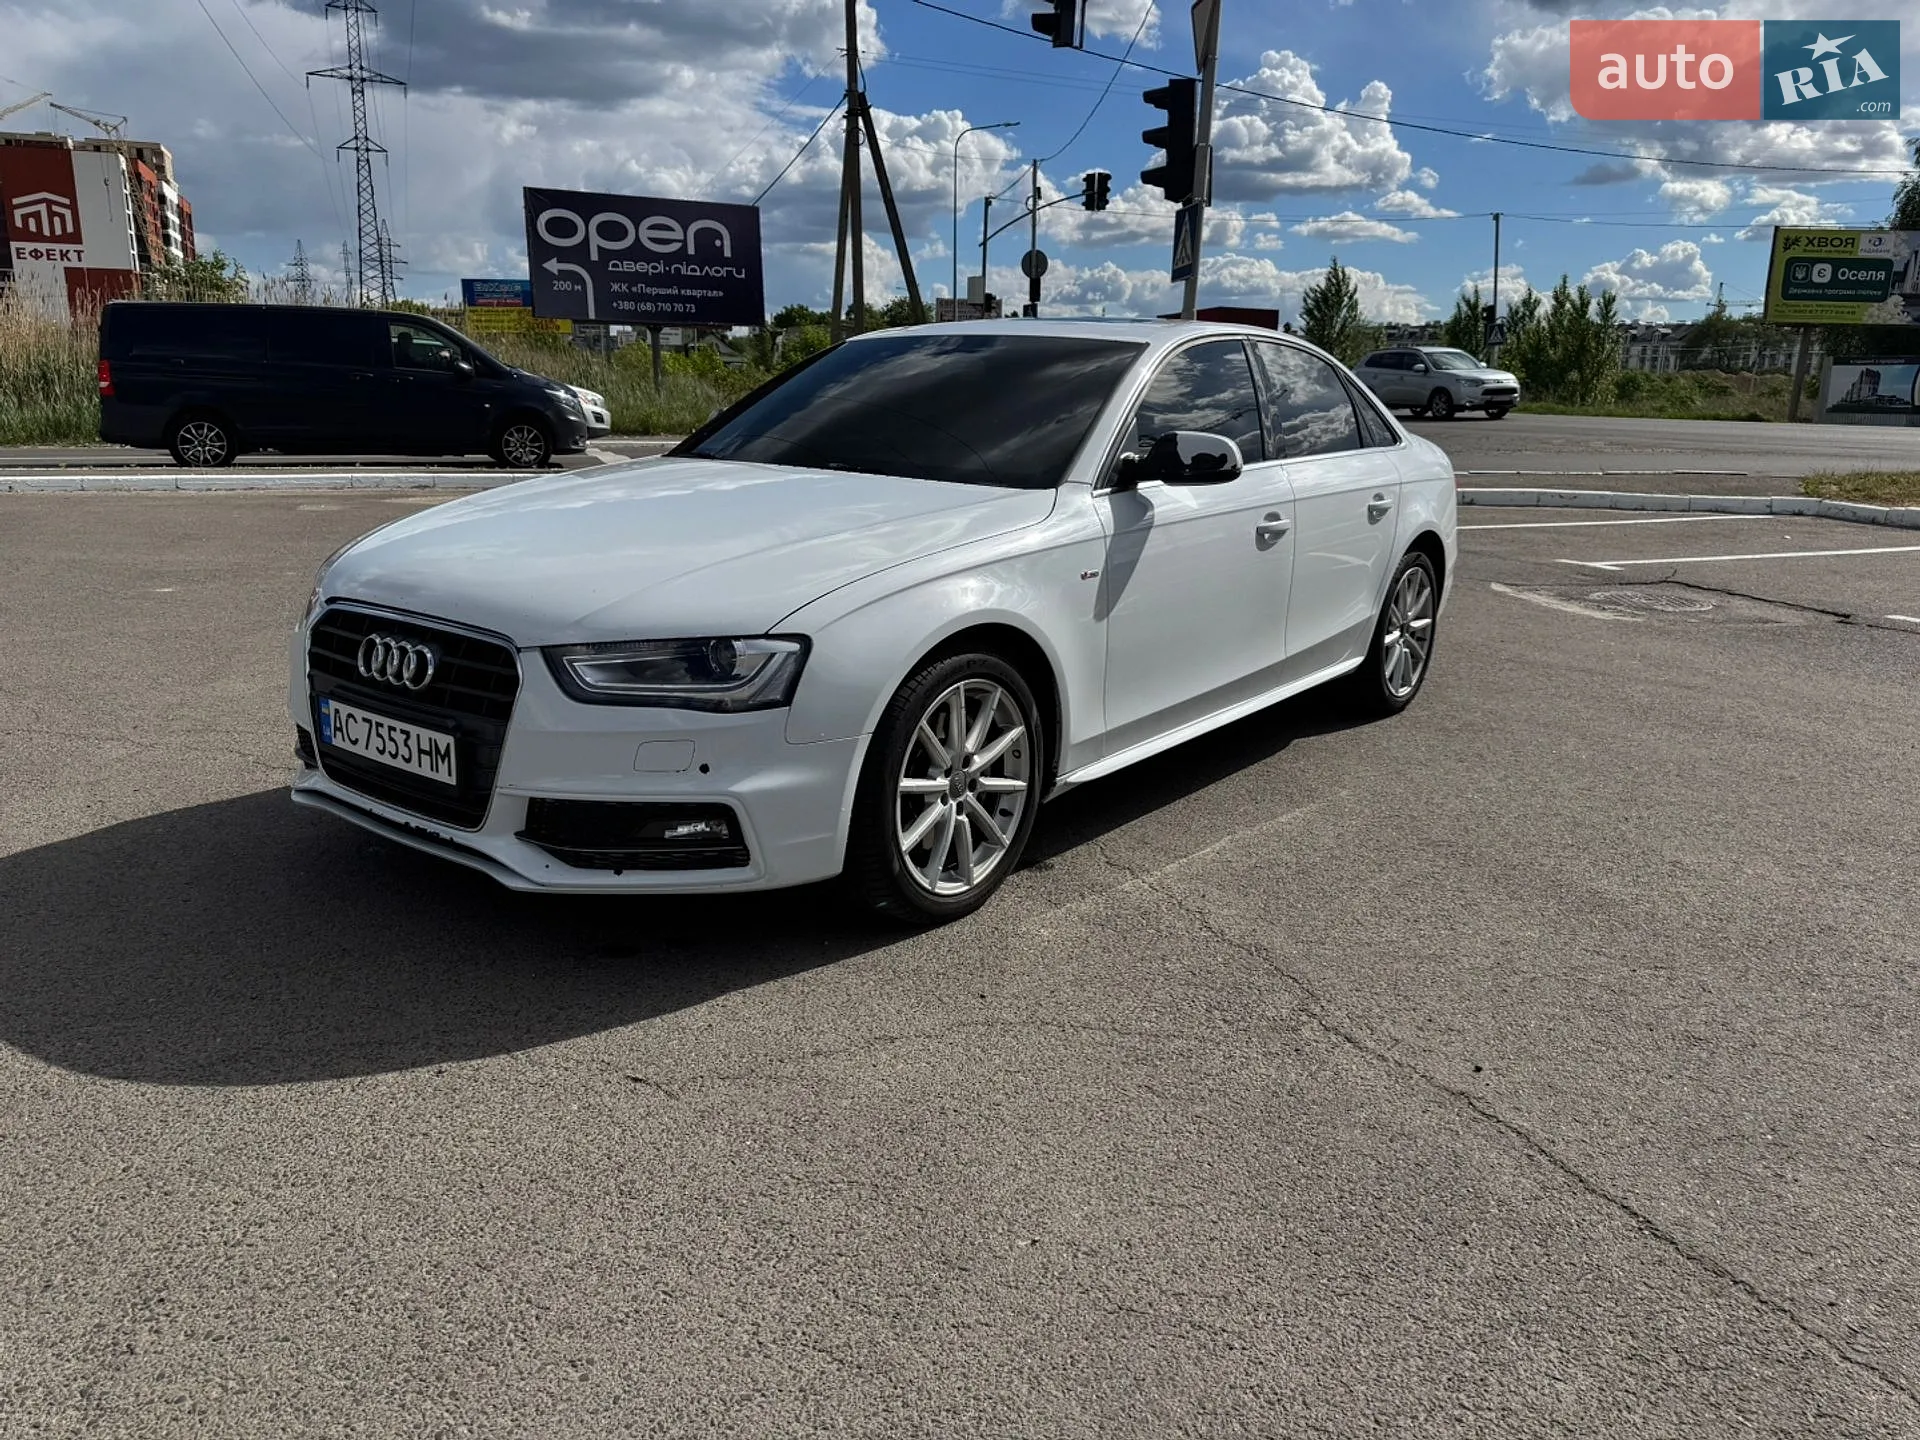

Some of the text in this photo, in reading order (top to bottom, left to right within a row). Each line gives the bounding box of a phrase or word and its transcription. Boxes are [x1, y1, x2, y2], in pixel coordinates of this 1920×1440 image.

[536, 208, 732, 261] open
[1805, 236, 1856, 249] ХВОЯ
[15, 246, 85, 262] ЕФЕКТ
[1838, 268, 1886, 281] Оселя
[552, 280, 573, 292] 200
[610, 281, 724, 298] ЖК «Перший квартал»
[612, 301, 696, 313] +380 (68) 710 70 73
